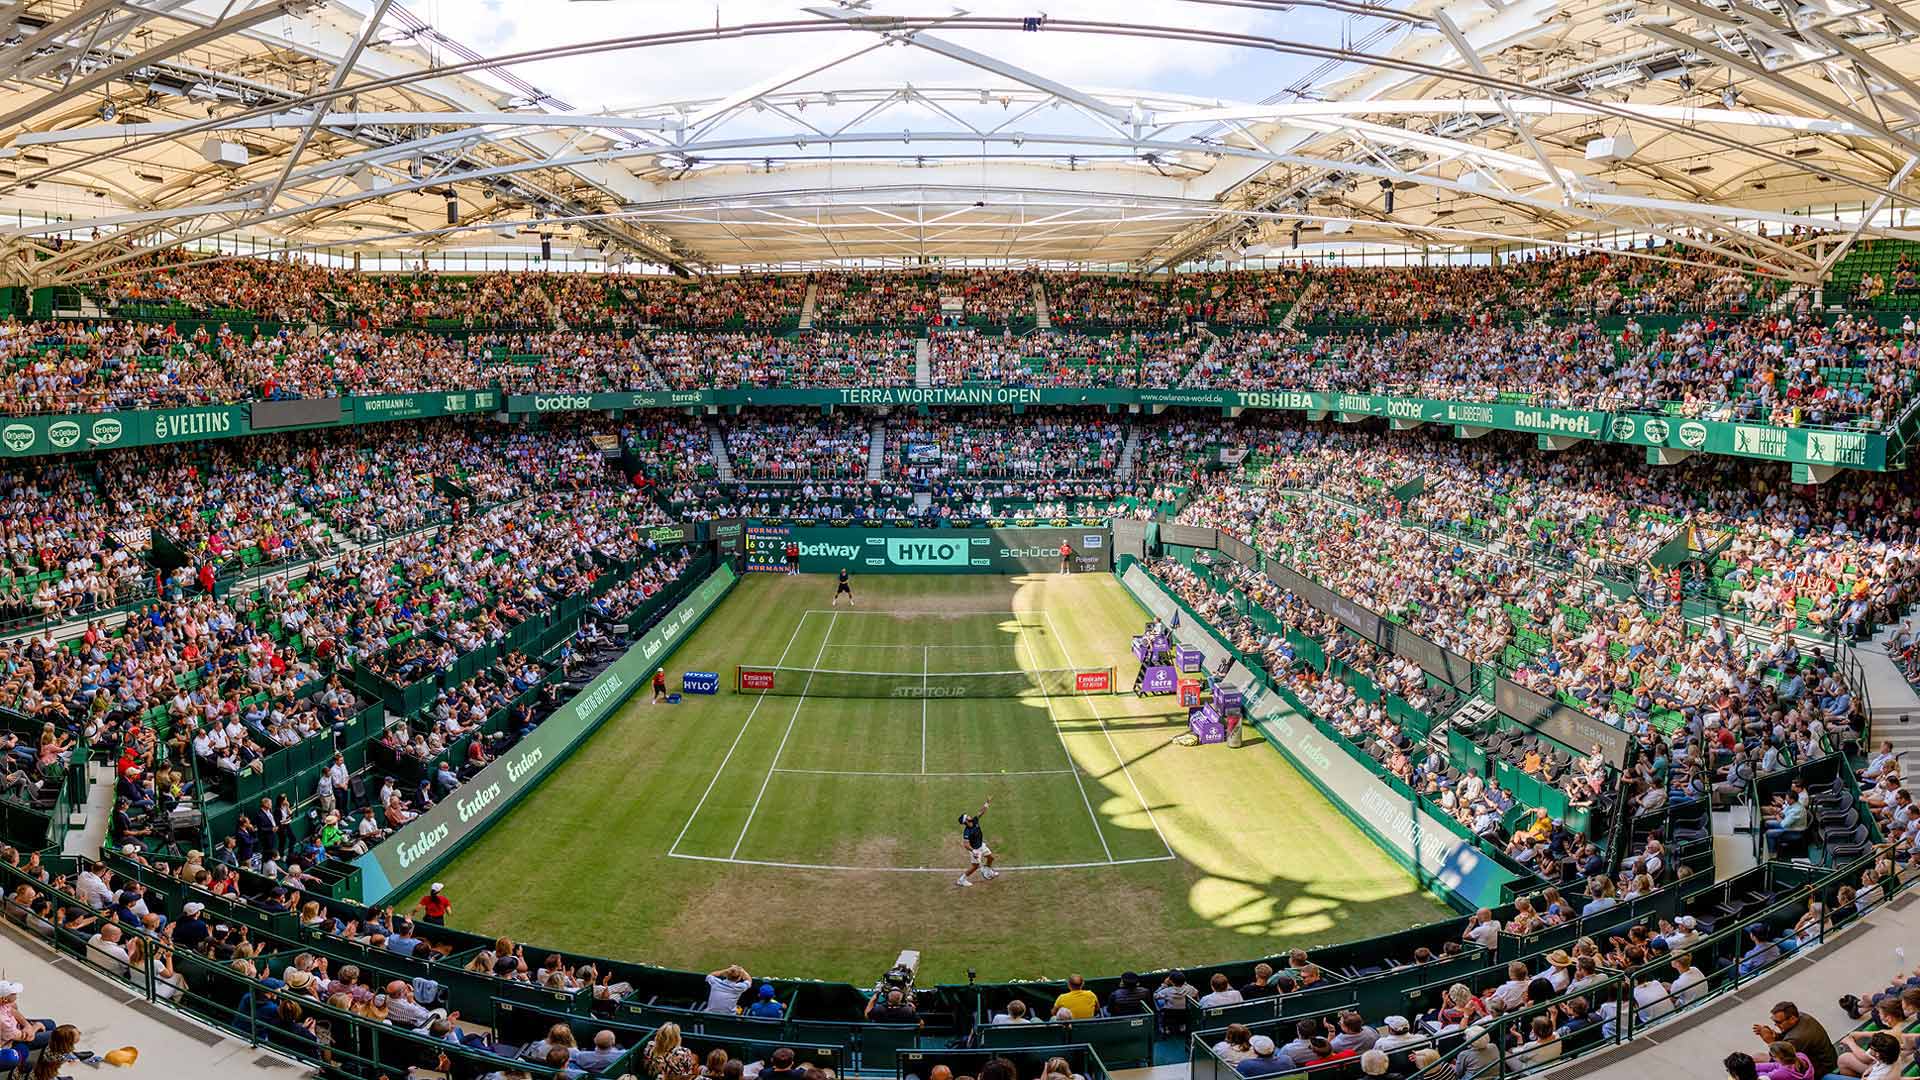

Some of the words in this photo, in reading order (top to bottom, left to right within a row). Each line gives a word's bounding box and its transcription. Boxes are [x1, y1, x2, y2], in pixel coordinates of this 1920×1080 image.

[535, 396, 592, 410] brother
[840, 390, 893, 403] TERRA
[897, 390, 992, 403] WORTMANN
[997, 390, 1041, 403] OPEN
[1238, 392, 1313, 408] TOSHIBA
[1345, 396, 1371, 411] VELTINS
[365, 400, 404, 410] WORTMANN
[1388, 398, 1424, 418] brother
[169, 412, 230, 436] VELTINS
[1760, 428, 1788, 444] BRUNO
[1836, 434, 1866, 450] BRUNO
[1760, 442, 1787, 456] KLEINE
[1836, 448, 1865, 465] KLEINE
[750, 541, 756, 549] 6
[758, 541, 765, 549] 0
[780, 541, 787, 550] 2
[798, 542, 860, 560] betway
[1000, 546, 1060, 558] SCHÜCO
[780, 556, 788, 564] 4
[506, 746, 543, 782] Enders
[457, 782, 500, 822] Enders
[396, 822, 448, 868] Enders
